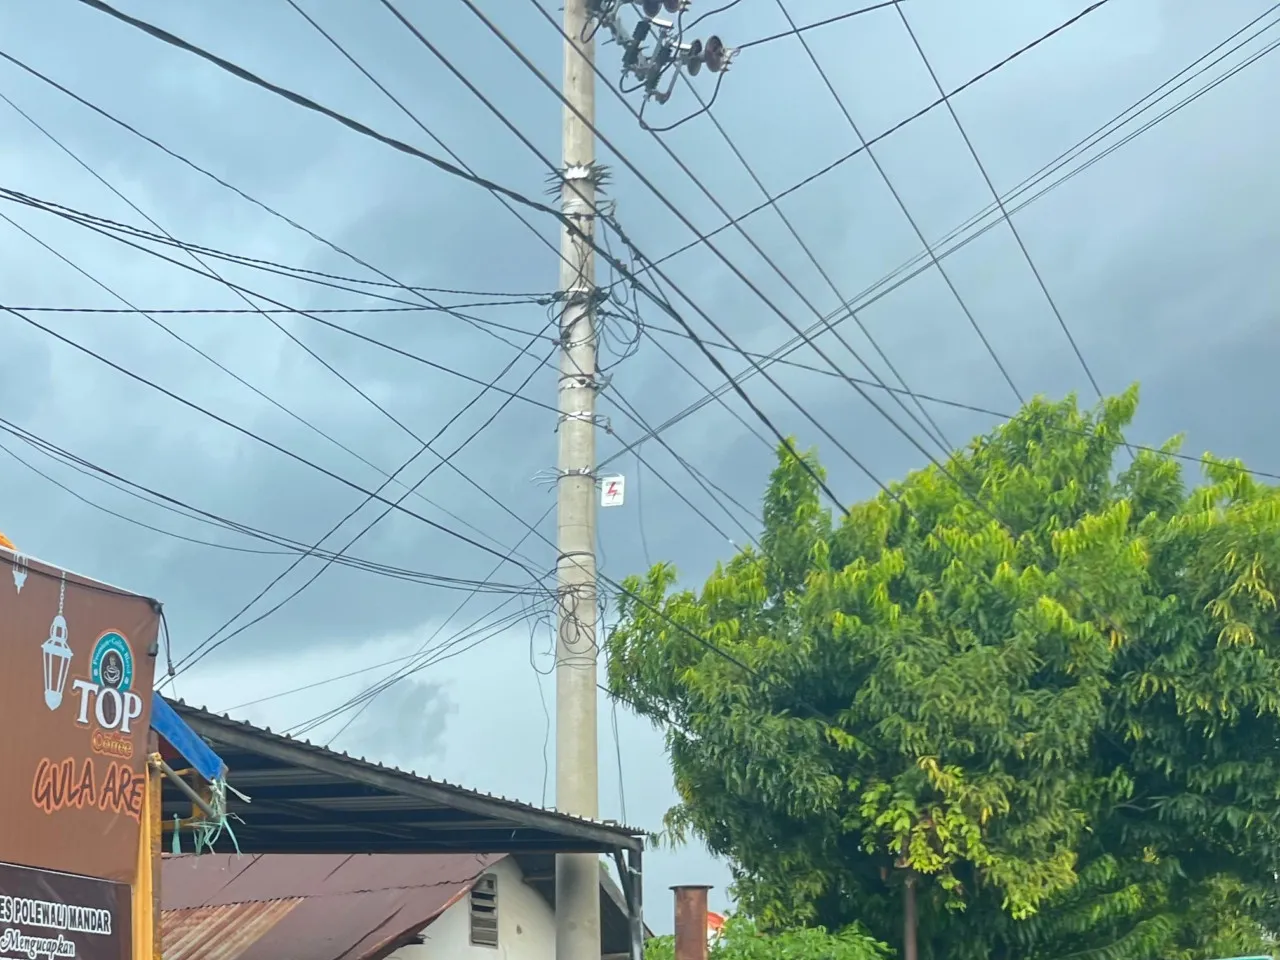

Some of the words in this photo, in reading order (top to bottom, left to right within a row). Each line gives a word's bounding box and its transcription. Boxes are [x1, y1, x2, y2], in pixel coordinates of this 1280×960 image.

[72, 679, 142, 733] TOP
[33, 759, 95, 811] GULA
[14, 897, 69, 930] POLEWALI
[69, 907, 111, 935] MANDAR
